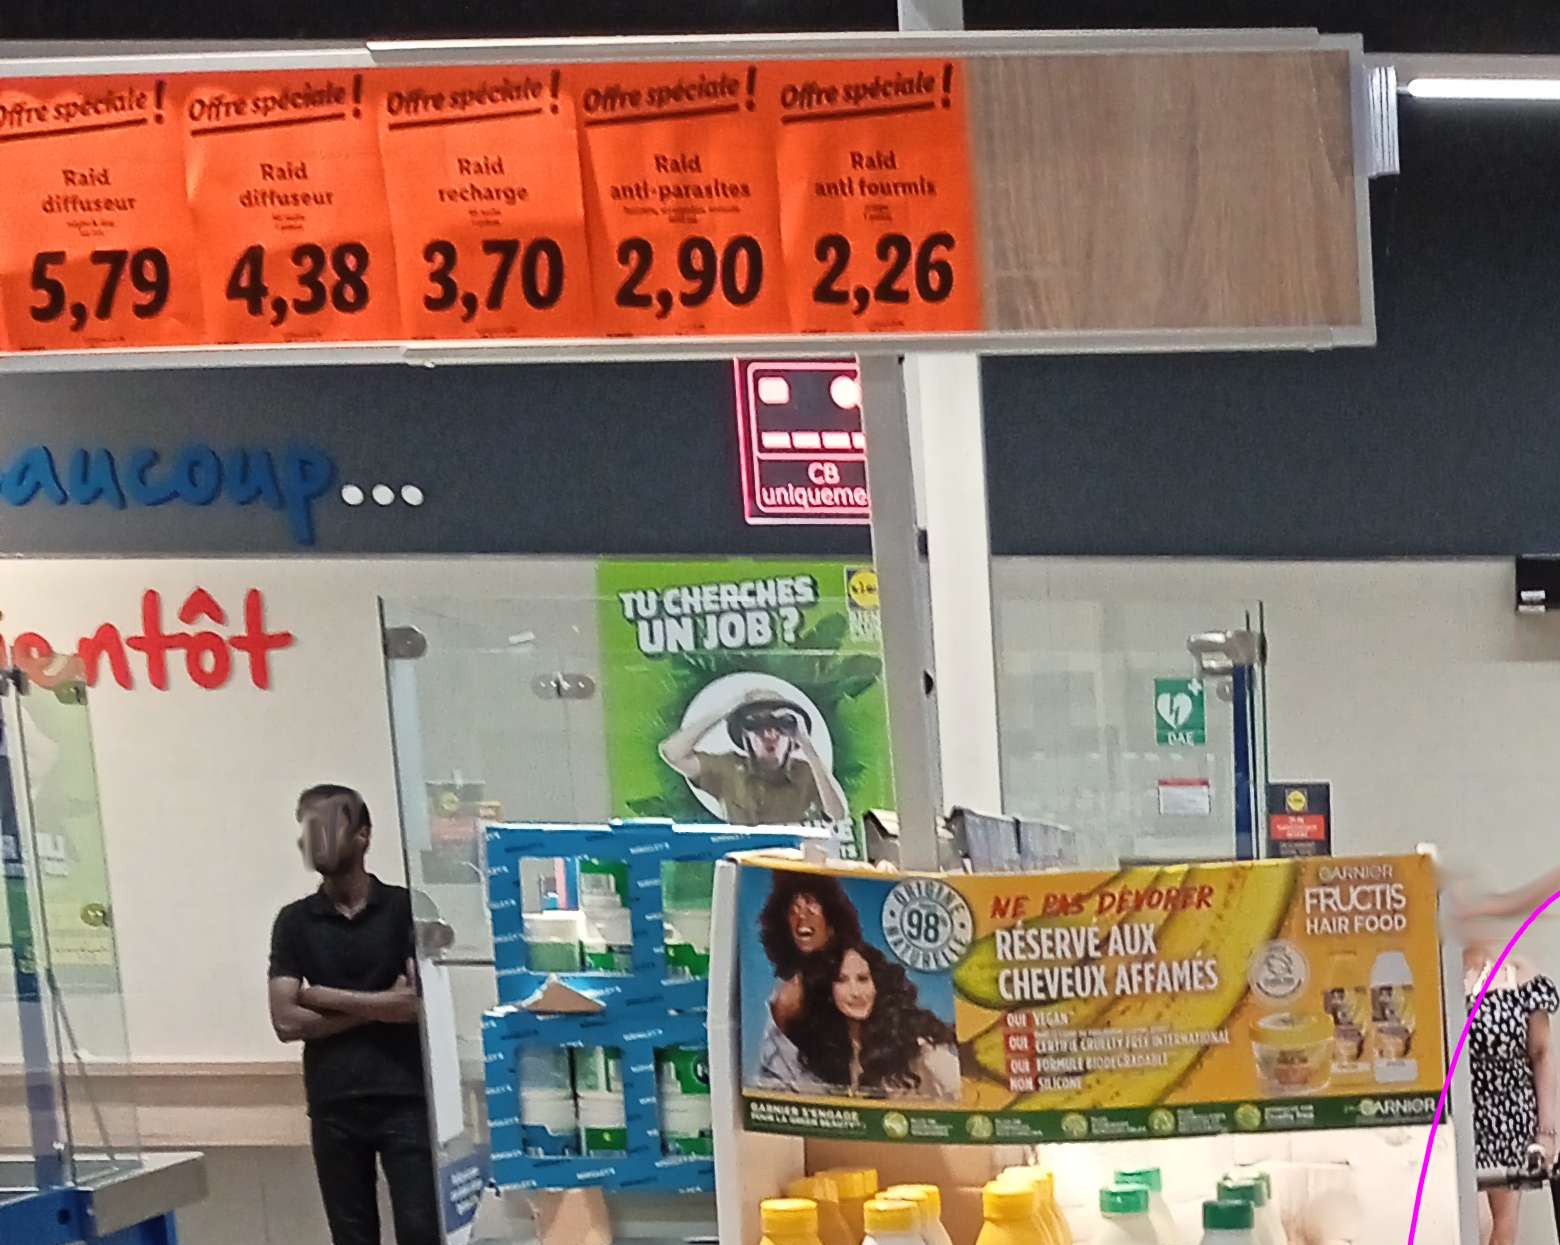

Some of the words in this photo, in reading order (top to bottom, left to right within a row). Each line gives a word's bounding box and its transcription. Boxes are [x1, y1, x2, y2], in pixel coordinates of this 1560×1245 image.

[387, 85, 446, 114] Offre
[449, 74, 542, 108] spéciale
[583, 82, 641, 113] Offre
[647, 70, 740, 107] spéciale
[780, 79, 838, 108] Offre
[841, 68, 935, 104] spéciale
[189, 91, 248, 121] Offre
[251, 80, 345, 112] spéciale
[259, 162, 308, 182] Raid
[457, 155, 504, 176] Raid
[654, 154, 702, 174] Raid
[850, 150, 898, 171] Raid
[62, 167, 111, 186] Raid
[814, 178, 855, 197] anti
[857, 175, 937, 197] fourmis
[239, 189, 334, 208] diffuseur
[437, 183, 529, 205] recharge
[610, 180, 751, 202] anti-parasites
[42, 194, 136, 213] diffuseur
[225, 241, 370, 326] 4,38
[423, 236, 565, 322] 3,70
[616, 233, 764, 320] 2,90
[812, 230, 956, 317] 2,26
[29, 249, 170, 331] 5,79
[808, 462, 840, 485] CB
[618, 589, 659, 619] TU
[662, 575, 818, 617] CHERCHES
[638, 617, 696, 655] UN
[701, 610, 773, 651] JOB
[990, 895, 1029, 919] NE
[1042, 892, 1086, 917] PAS
[1303, 883, 1407, 914] FRUCTIS
[1306, 918, 1350, 936] HAIR
[1353, 914, 1408, 934] FOOD
[995, 919, 1103, 961] RÉSERVE
[1108, 922, 1158, 956] AUX
[998, 965, 1109, 1001] CHEVEUX
[1114, 951, 1220, 996] AFFAMÉS
[1006, 1013, 1027, 1027] OUI
[1008, 1036, 1029, 1050] OUI
[1010, 1059, 1031, 1073] OUI
[1010, 1076, 1034, 1092] NON
